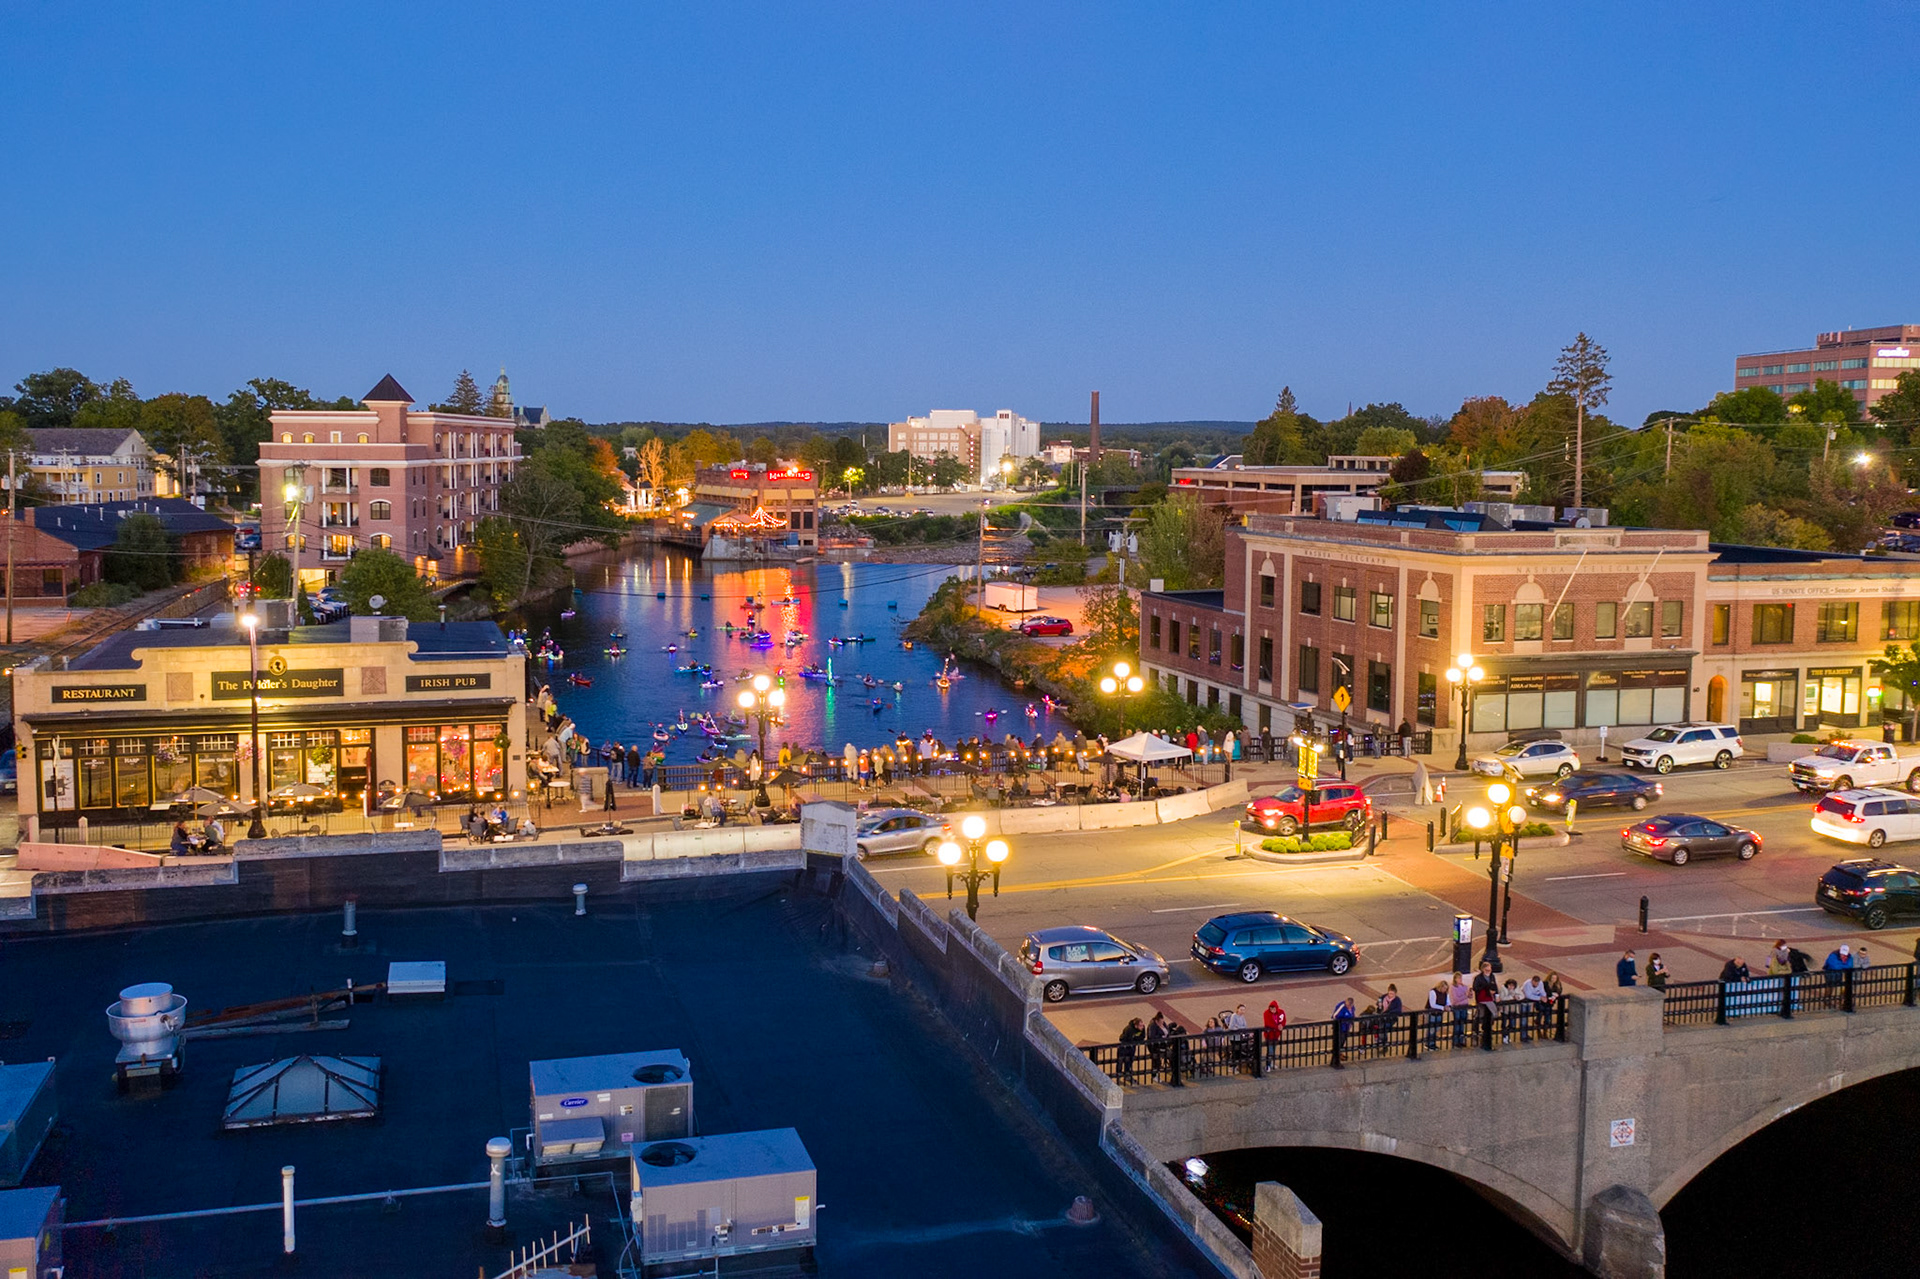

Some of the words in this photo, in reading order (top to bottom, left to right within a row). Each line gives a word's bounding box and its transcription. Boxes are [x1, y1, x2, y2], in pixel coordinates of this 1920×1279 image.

[769, 472, 811, 480] MARGRITAS
[1516, 566, 1565, 574] NASHUA
[217, 680, 239, 691] The
[291, 678, 339, 690] Daughter
[420, 678, 450, 688] IRISH
[455, 677, 477, 687] PUB
[62, 688, 137, 700] RESTAURANT
[563, 1099, 586, 1107] Carrier
